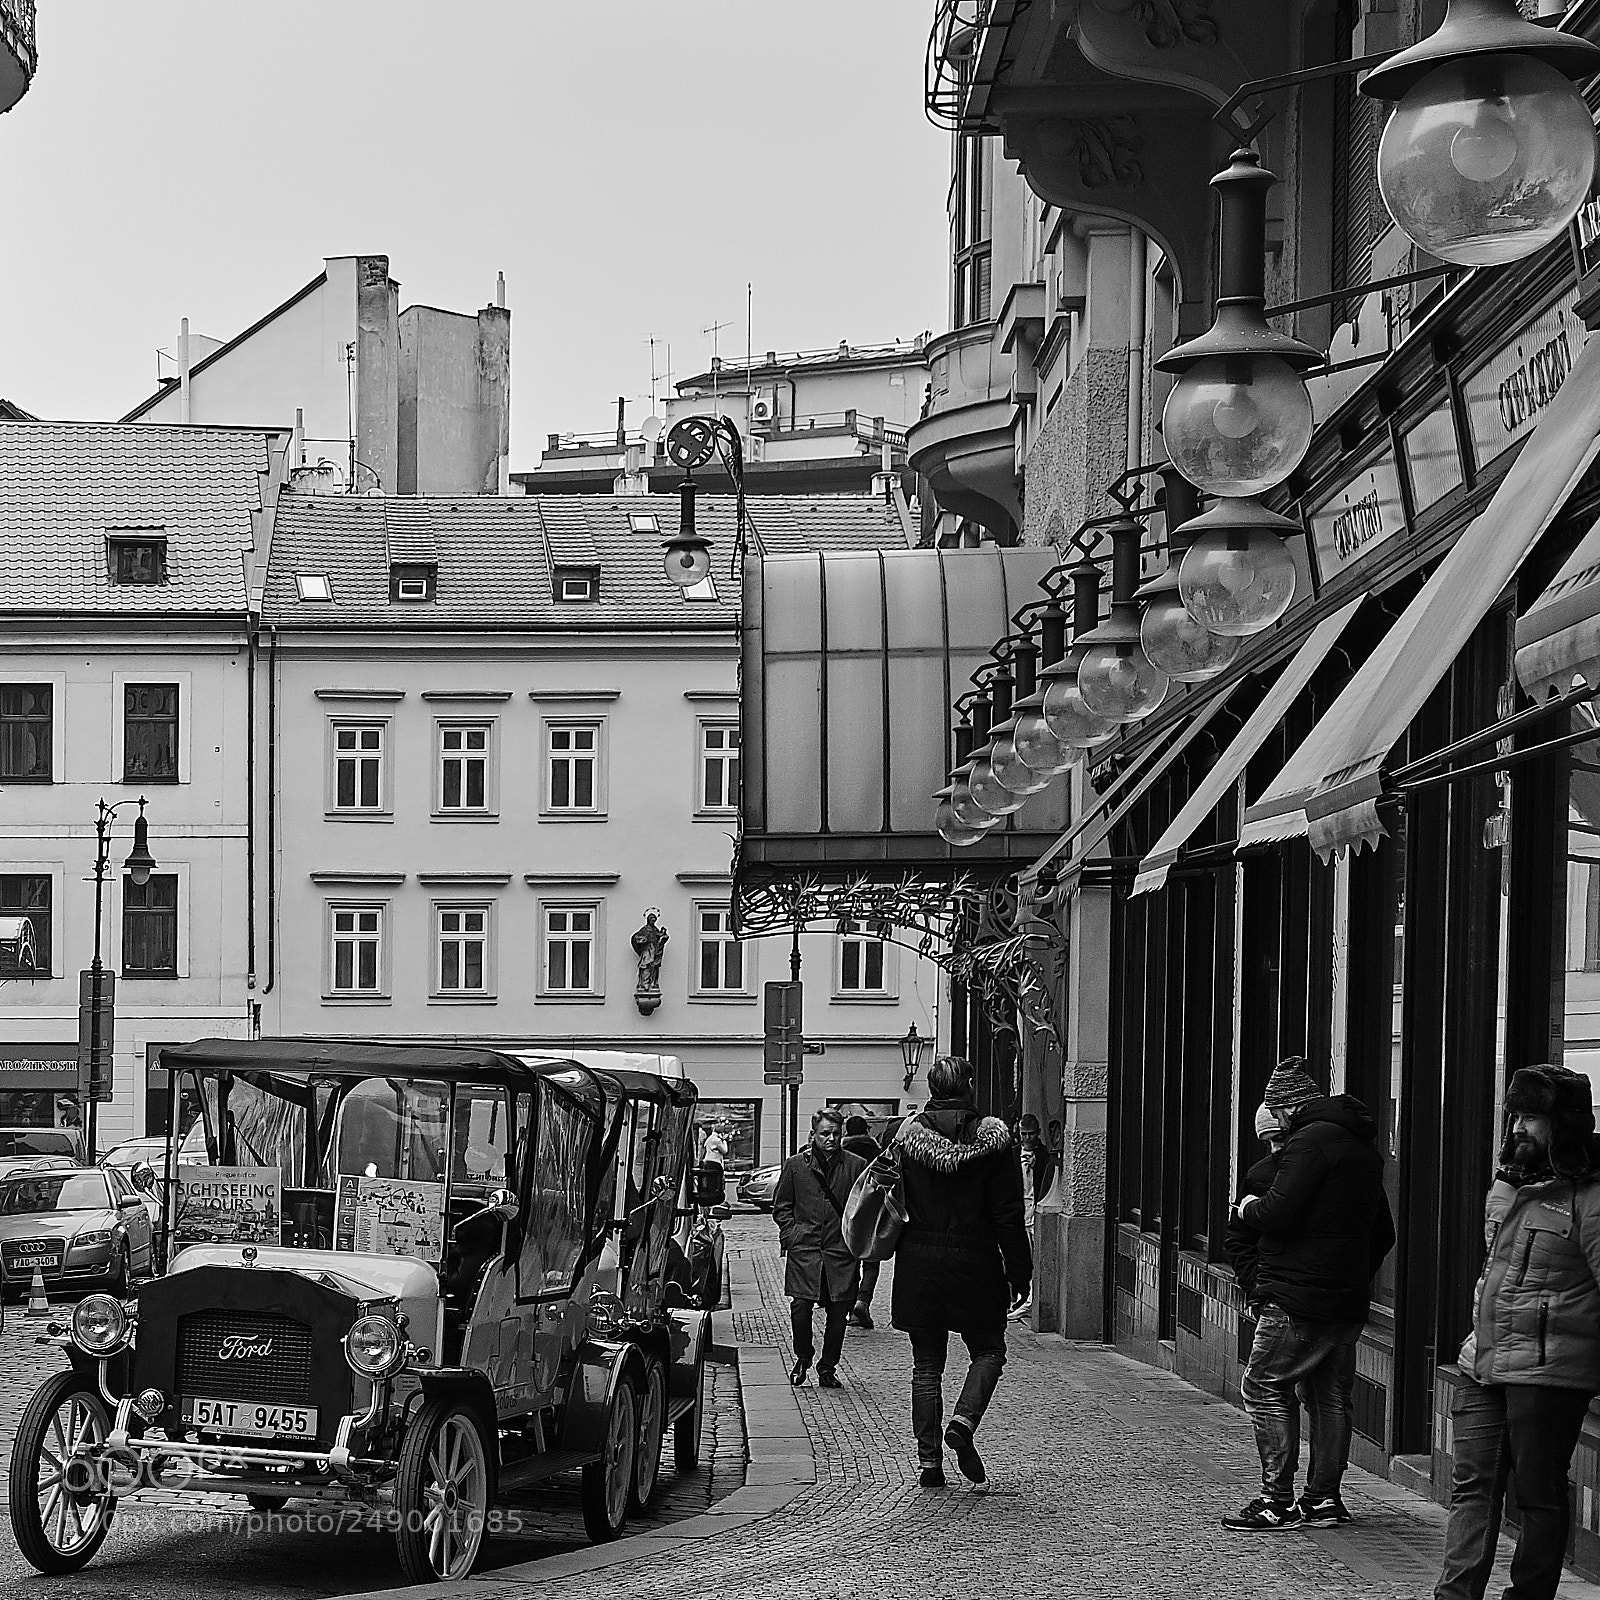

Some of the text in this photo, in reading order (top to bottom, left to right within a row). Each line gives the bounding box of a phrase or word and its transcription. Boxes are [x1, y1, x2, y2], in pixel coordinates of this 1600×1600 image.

[345, 1179, 354, 1188] A
[176, 1183, 275, 1198] SIGHTSEEING
[201, 1198, 253, 1211] TOURS
[344, 1197, 352, 1206] B
[343, 1216, 350, 1225] C
[218, 1335, 273, 1360] Ford
[197, 1402, 308, 1433] 5AT 9455
